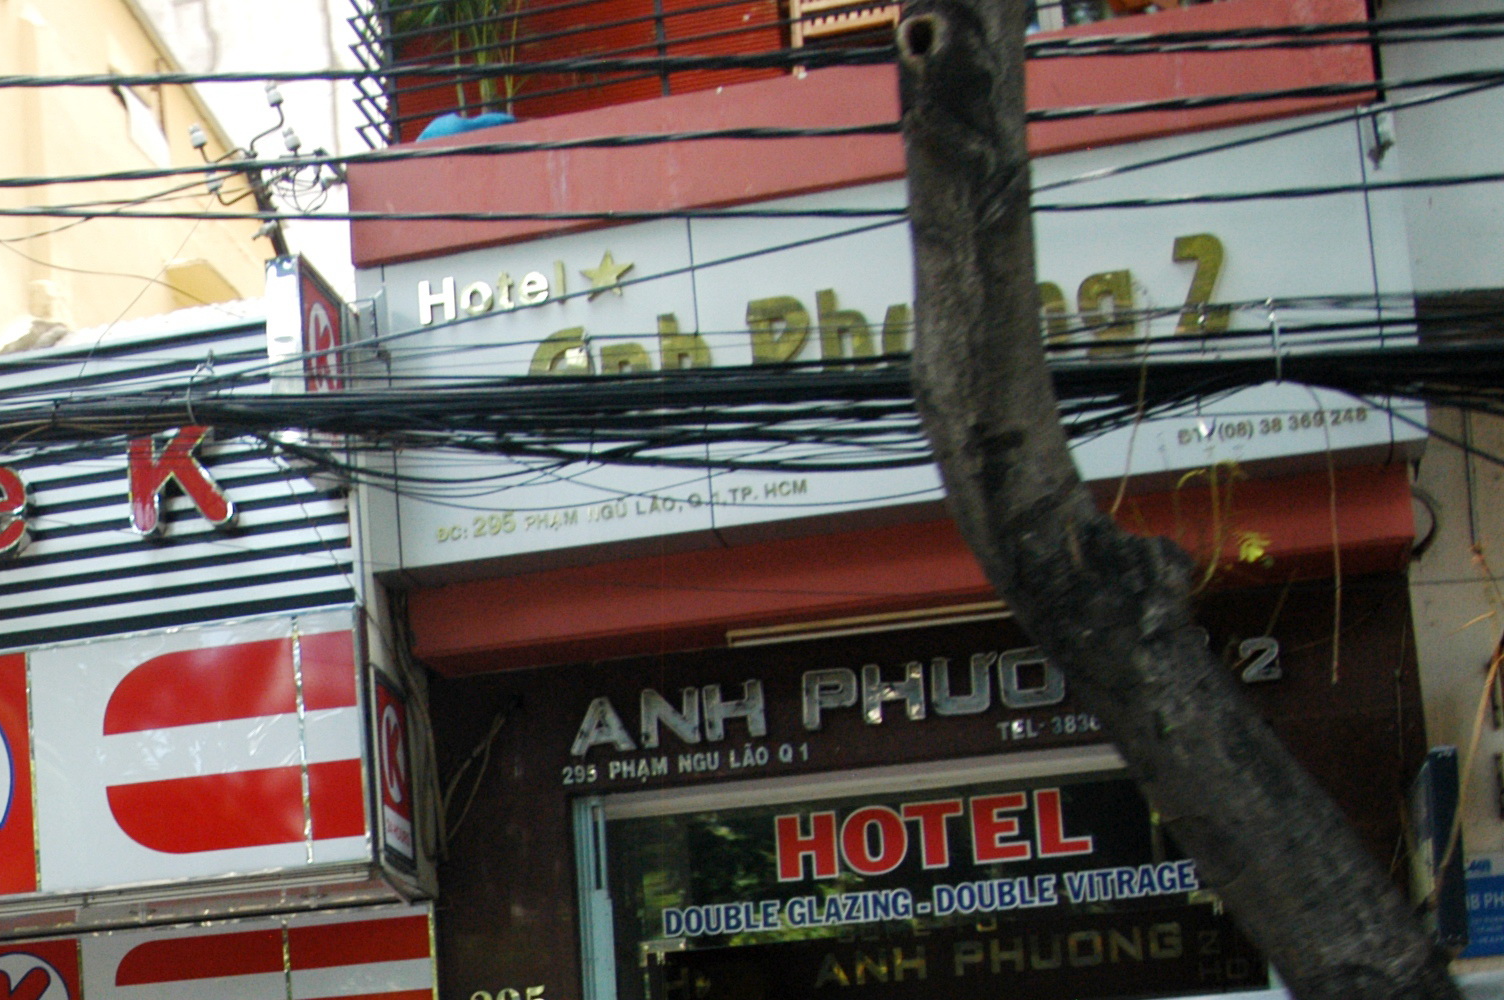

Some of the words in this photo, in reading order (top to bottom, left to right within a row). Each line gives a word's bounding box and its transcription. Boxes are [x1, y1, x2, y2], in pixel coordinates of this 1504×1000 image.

[418, 261, 566, 325] Hotel
[127, 426, 237, 538] K
[472, 514, 517, 538] 295
[765, 478, 808, 498] HCM
[570, 678, 768, 757] ANH
[1238, 636, 1283, 684] 2
[609, 756, 668, 782] PHẠM
[728, 744, 770, 769] LÃO
[774, 787, 1093, 883] HOTEL
[663, 899, 781, 939] DOUBLE
[786, 888, 913, 928] GLAZING
[935, 874, 1058, 917] DOUBLE
[1066, 859, 1198, 903] VITRAGE
